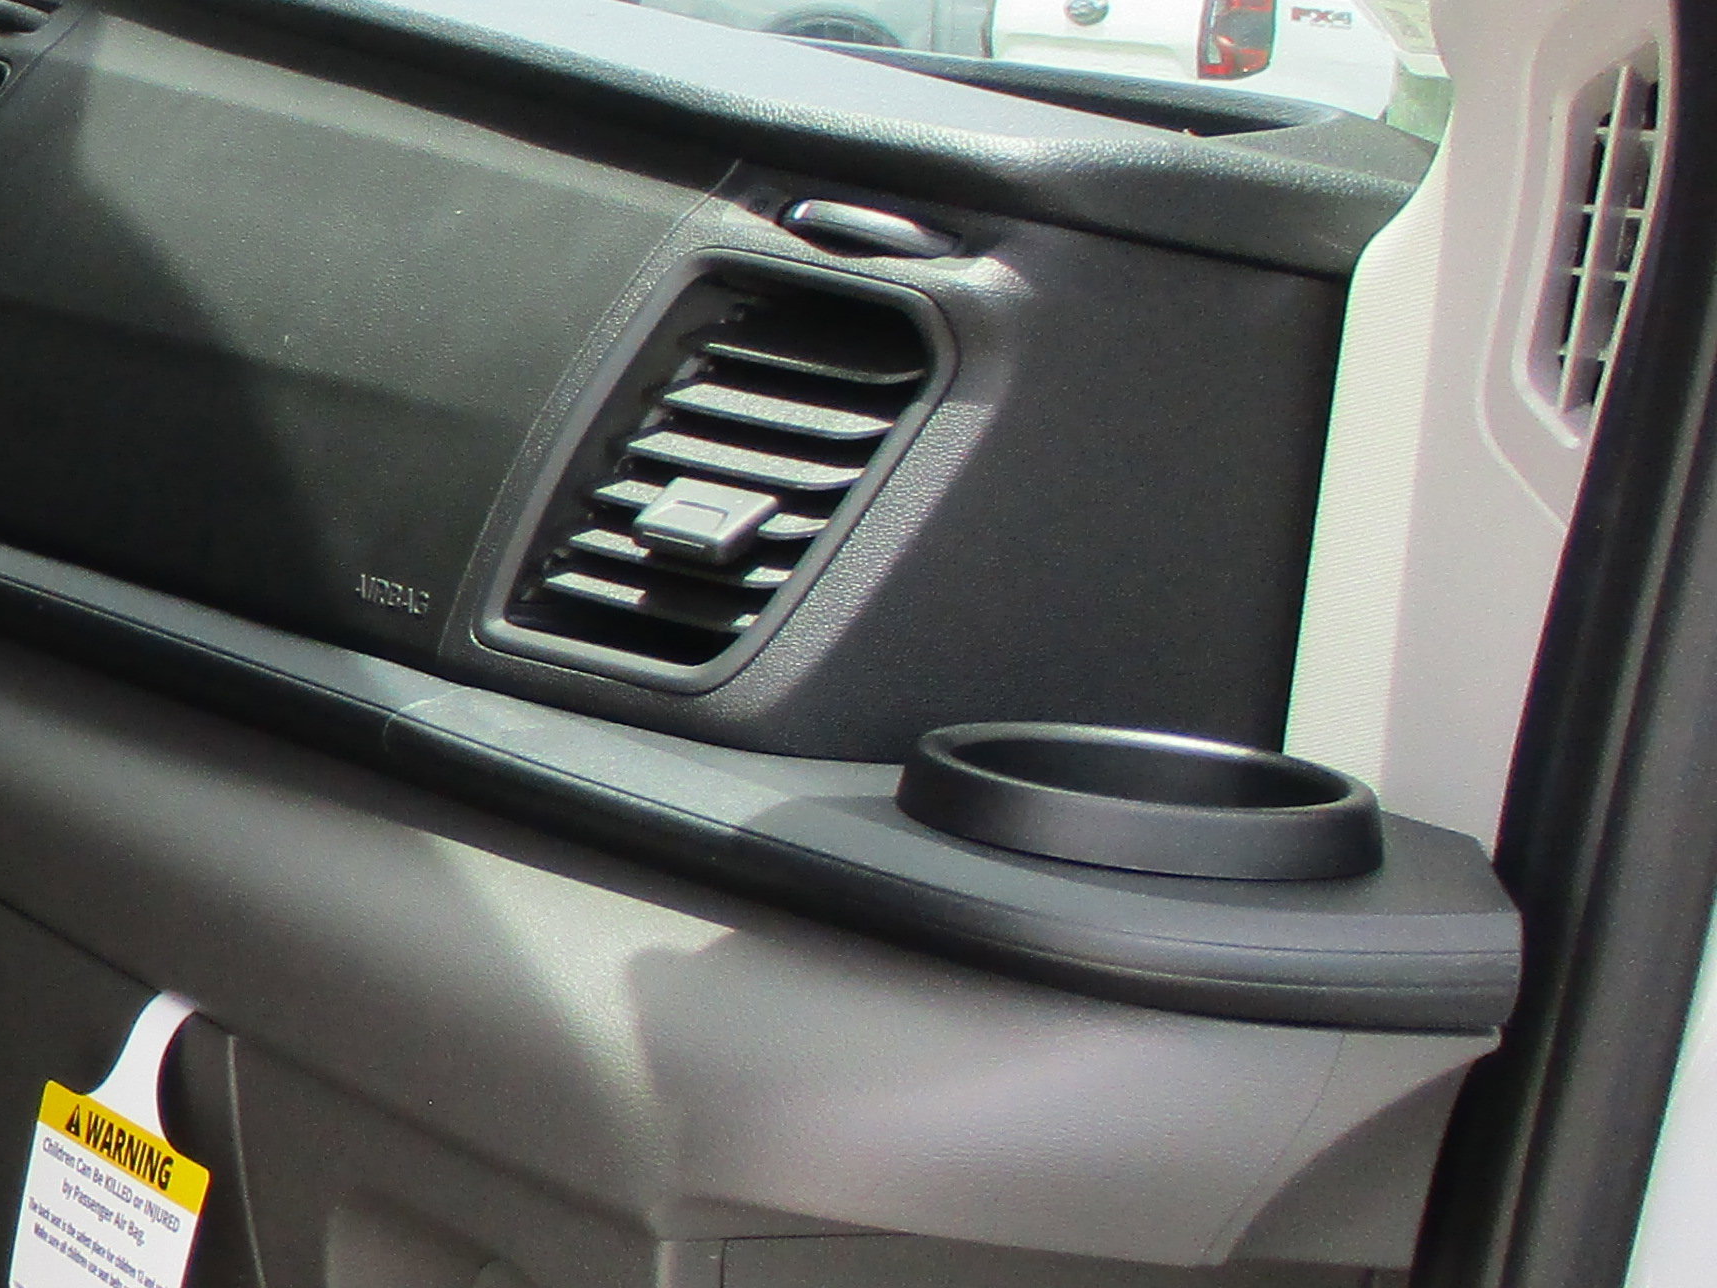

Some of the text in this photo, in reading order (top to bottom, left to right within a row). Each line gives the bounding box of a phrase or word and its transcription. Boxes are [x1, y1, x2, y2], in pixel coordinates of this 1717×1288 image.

[1291, 6, 1352, 29] FX4
[85, 1110, 174, 1191] WARNING
[43, 1137, 180, 1233] Children Can Be KILLED or INJURED
[62, 1178, 73, 1200] by
[73, 1185, 114, 1222] Passenger
[114, 1212, 127, 1230] Air
